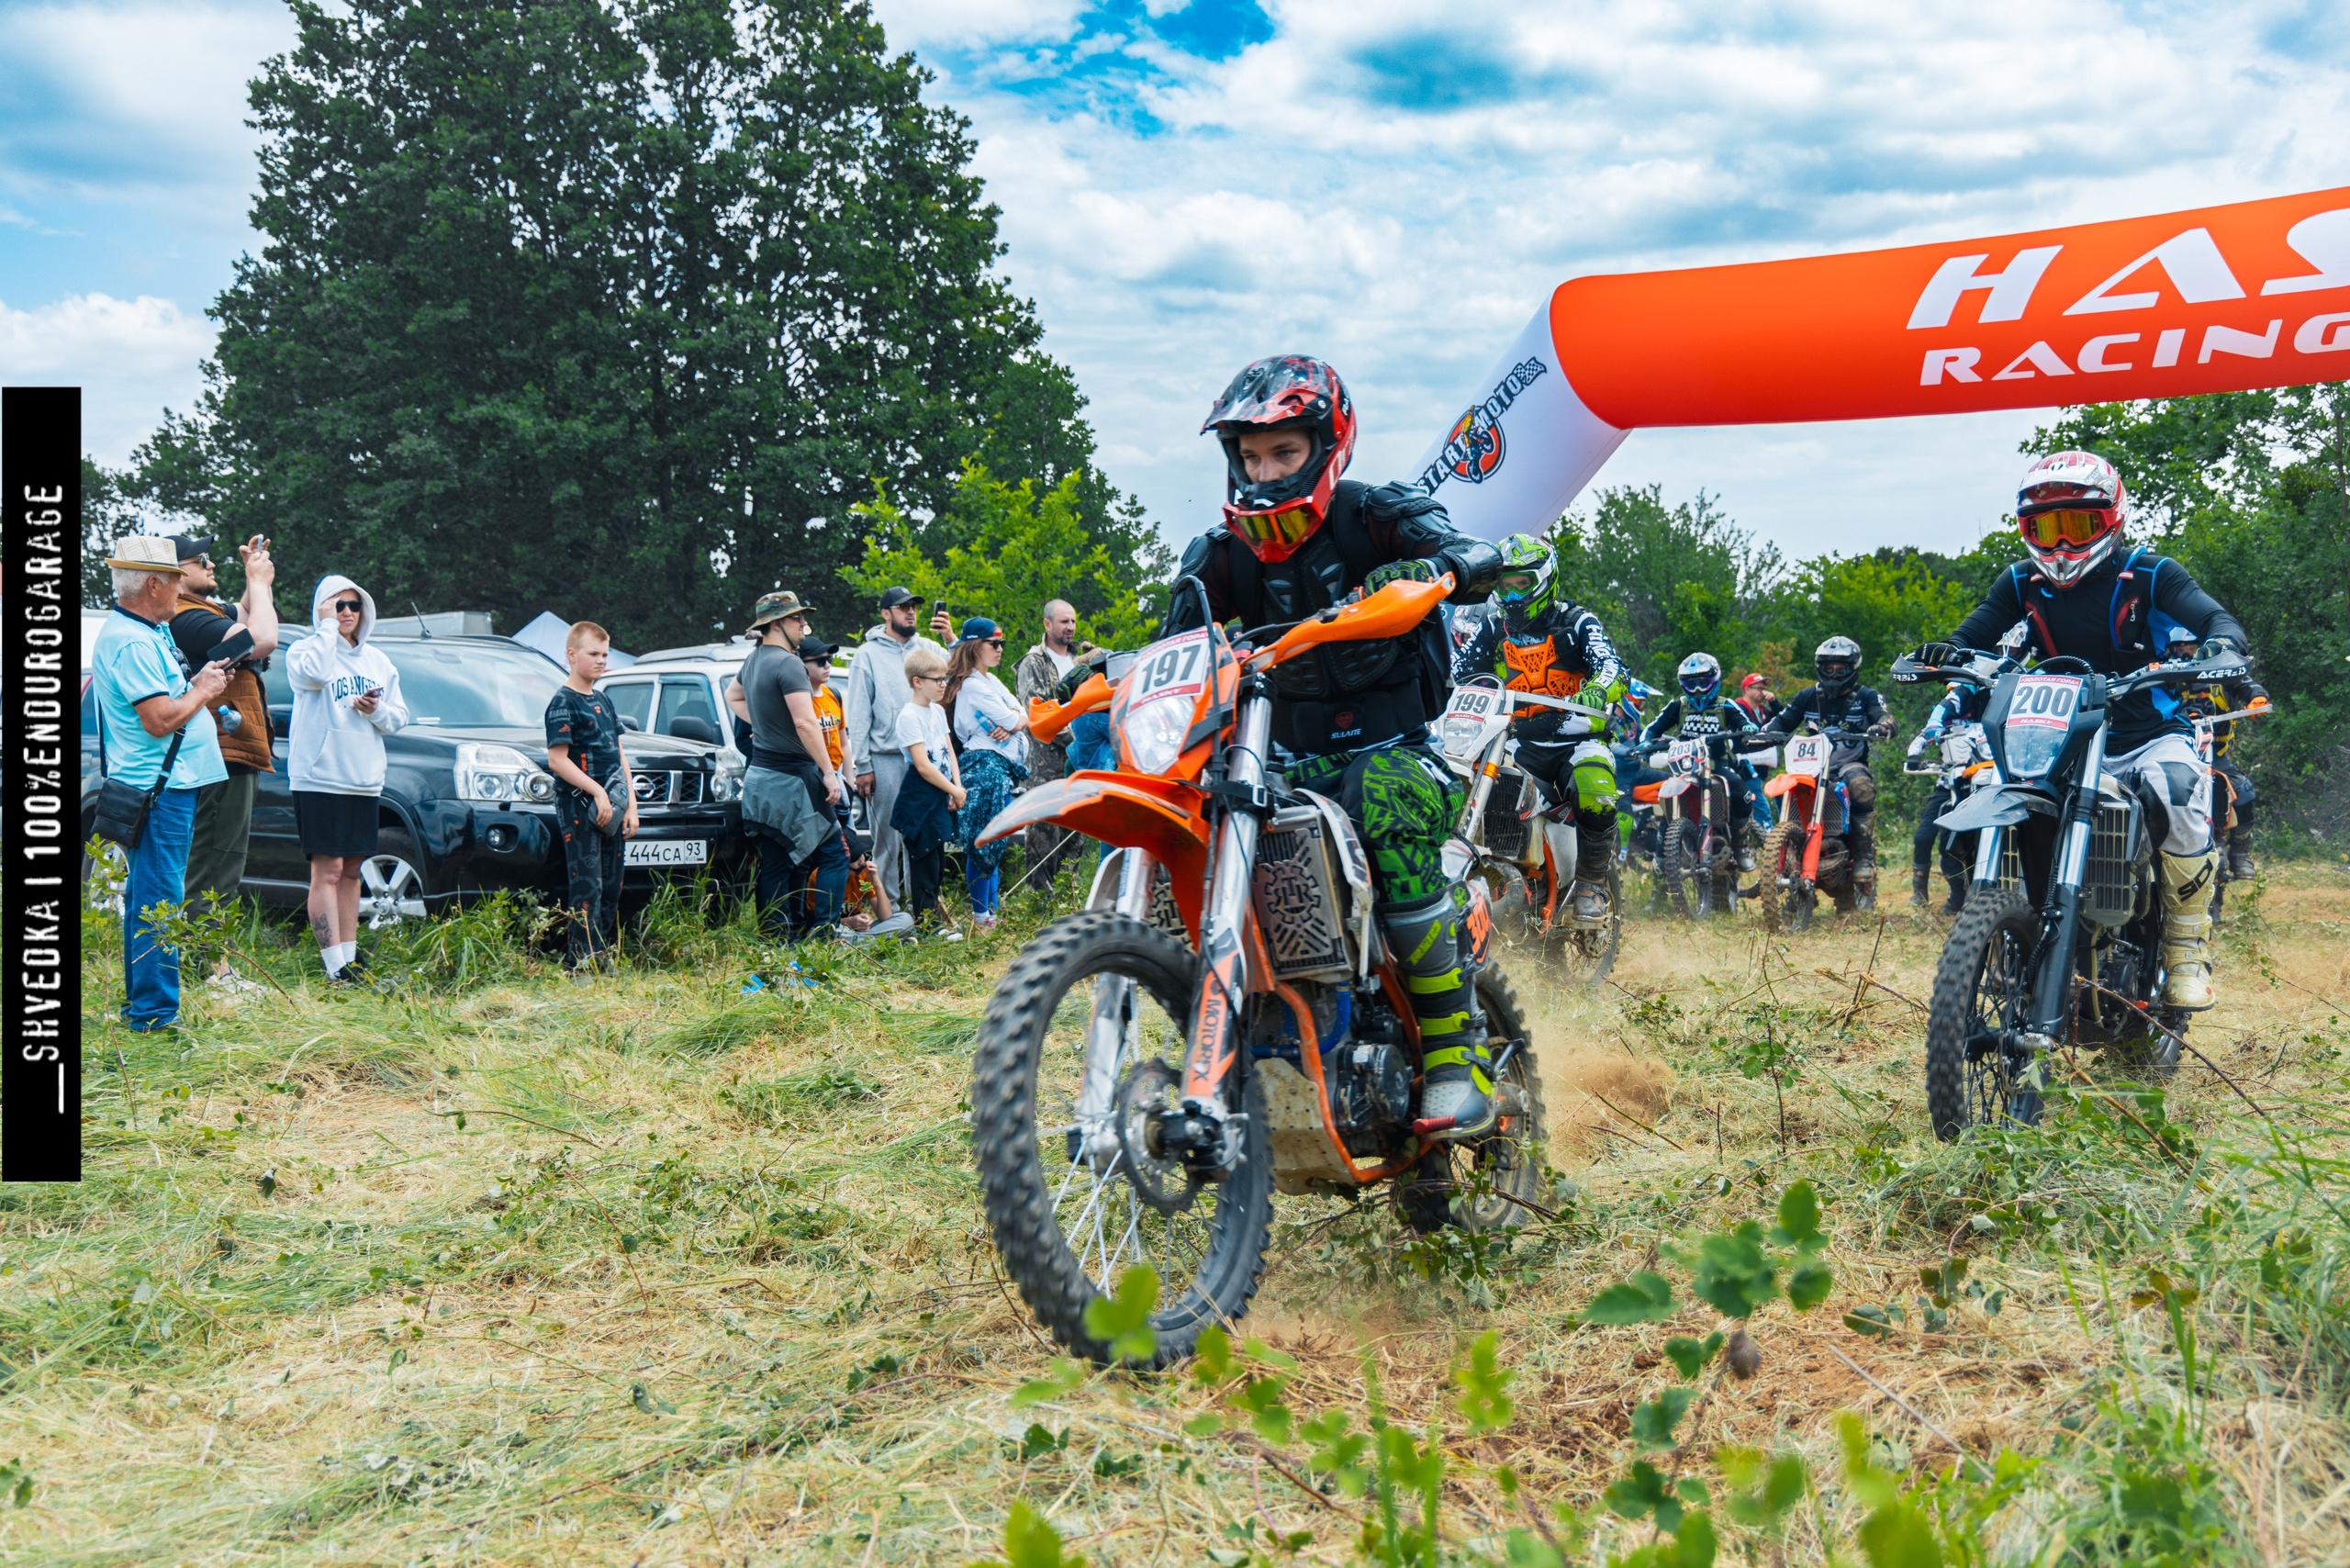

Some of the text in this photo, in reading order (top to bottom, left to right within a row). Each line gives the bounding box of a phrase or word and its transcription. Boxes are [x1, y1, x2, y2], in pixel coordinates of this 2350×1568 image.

[1919, 311, 2350, 386] RACING
[1417, 372, 1525, 496] START MOTO
[1142, 644, 1202, 694] 197
[1454, 693, 1490, 714] 199
[2011, 685, 2075, 717] 200
[1331, 728, 1362, 739] SULAITE
[1671, 744, 1691, 757] 203
[1797, 742, 1817, 757] 84
[624, 842, 700, 863] 444CA 93
